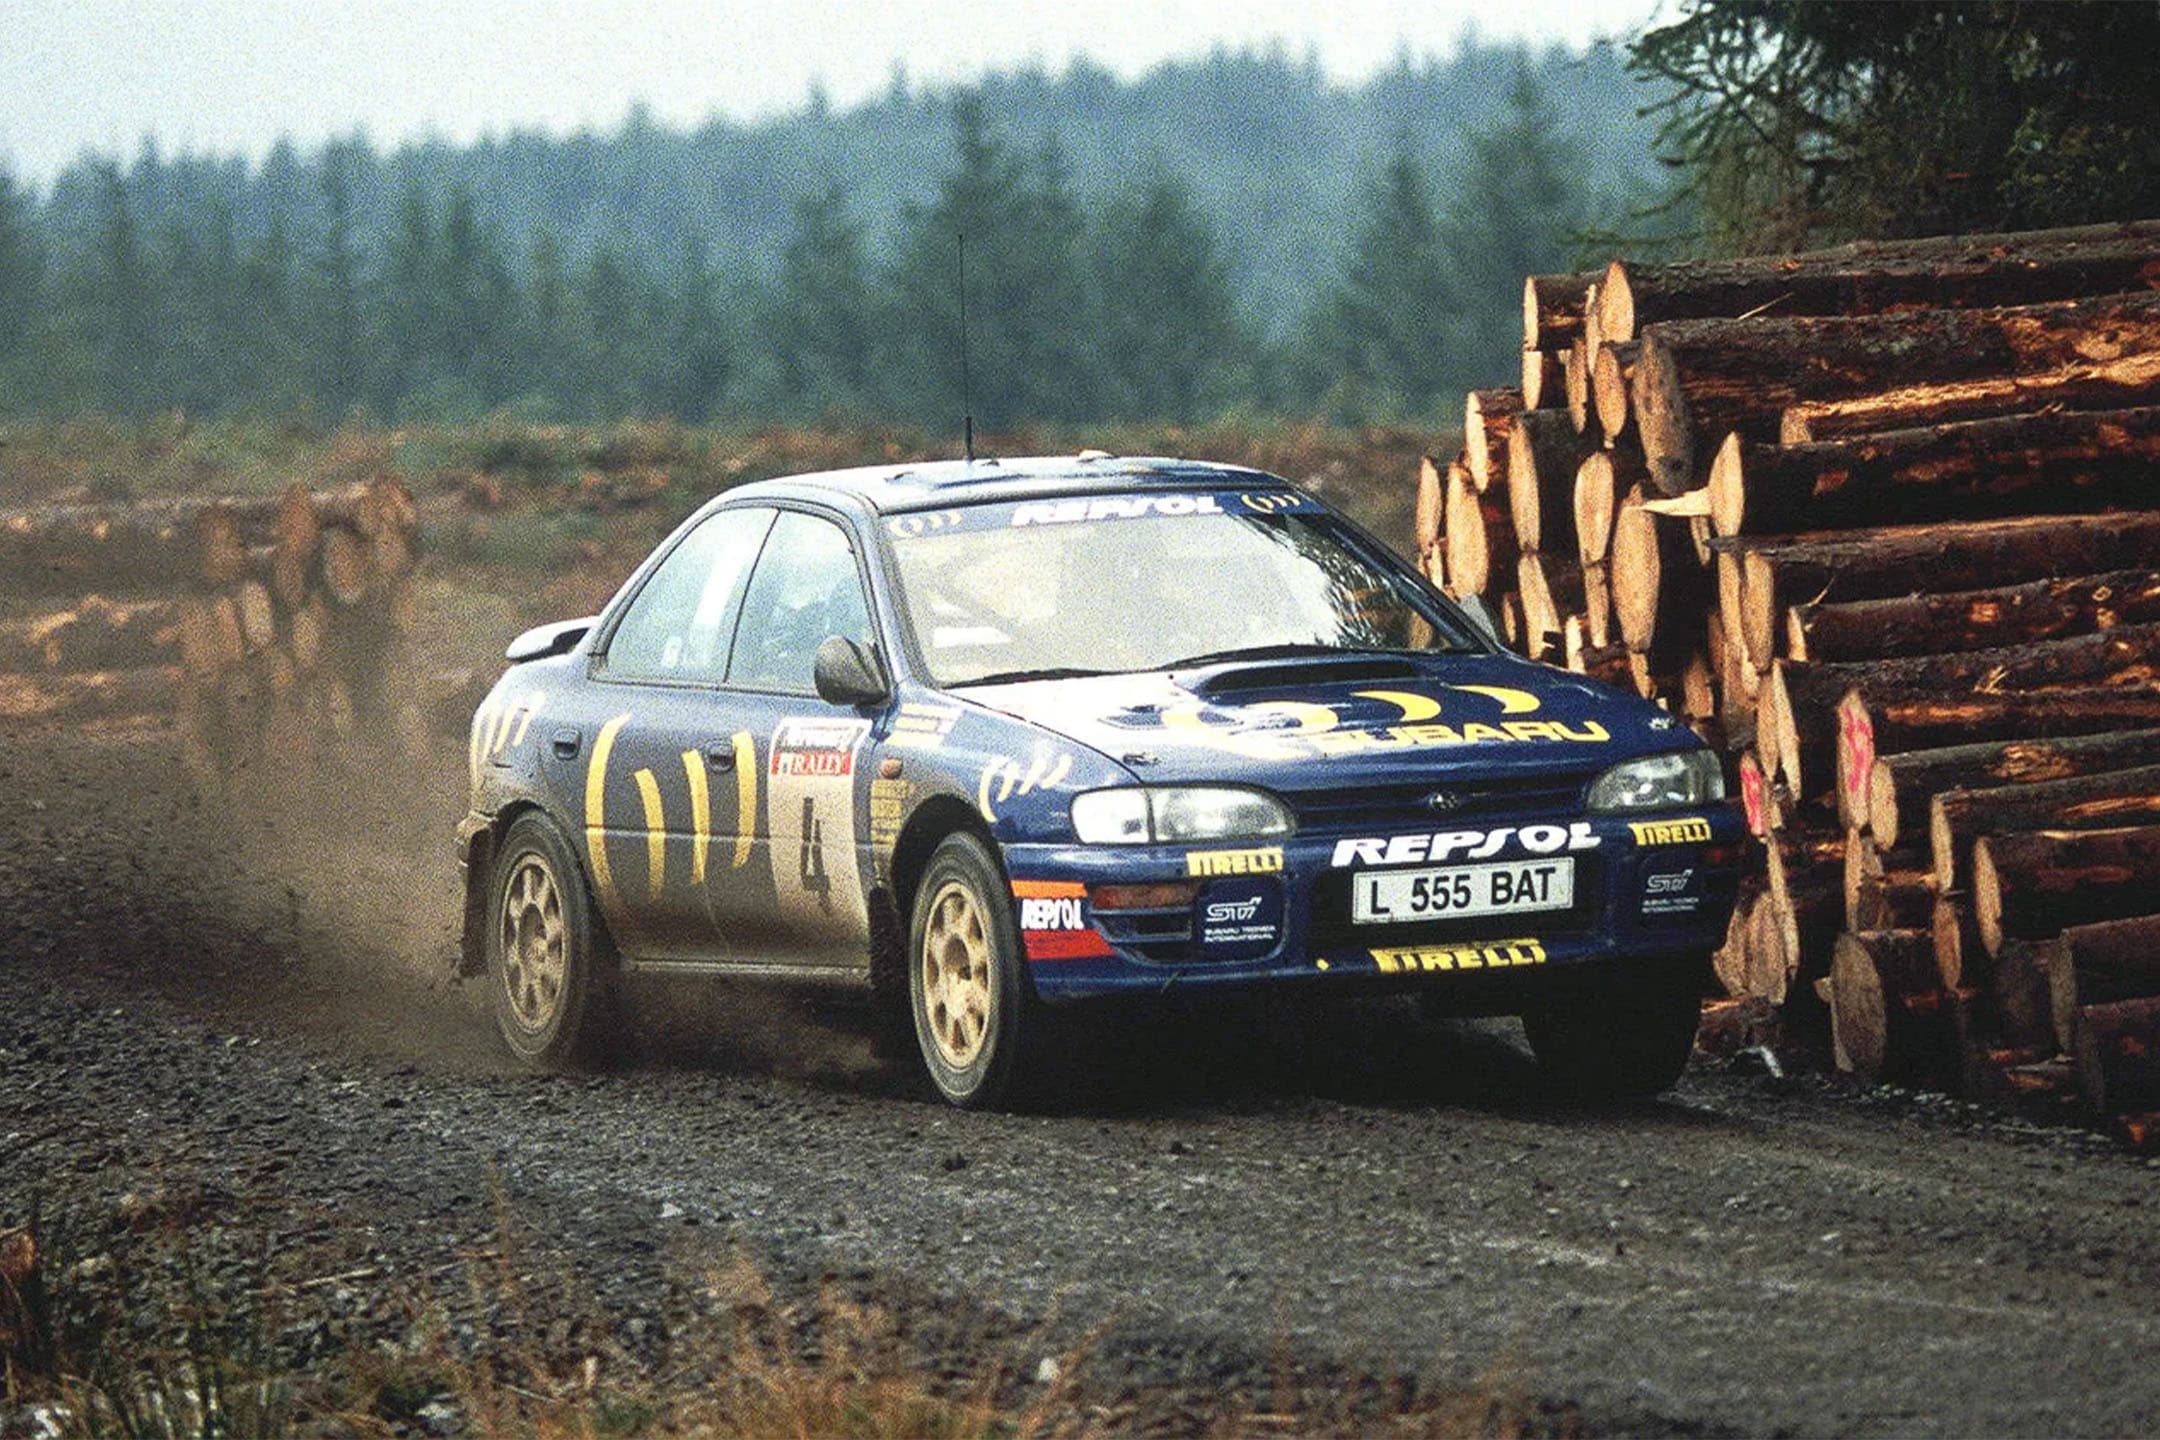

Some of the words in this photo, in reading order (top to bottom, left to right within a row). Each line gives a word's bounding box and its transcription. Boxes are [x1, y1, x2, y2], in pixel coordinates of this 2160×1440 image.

[1011, 496, 1223, 526] REPSOL
[1316, 721, 1611, 753] SUBARU
[791, 752, 846, 775] RALLY
[1331, 822, 1601, 867] REPSOL
[1627, 817, 1711, 846] PIRELLI
[1186, 847, 1284, 876] PIRELLI
[1370, 880, 1390, 914] L
[1411, 875, 1471, 912] 555
[1490, 867, 1556, 905] BAT
[1021, 898, 1084, 930] REPSOL
[1369, 938, 1546, 973] PIRELLI
